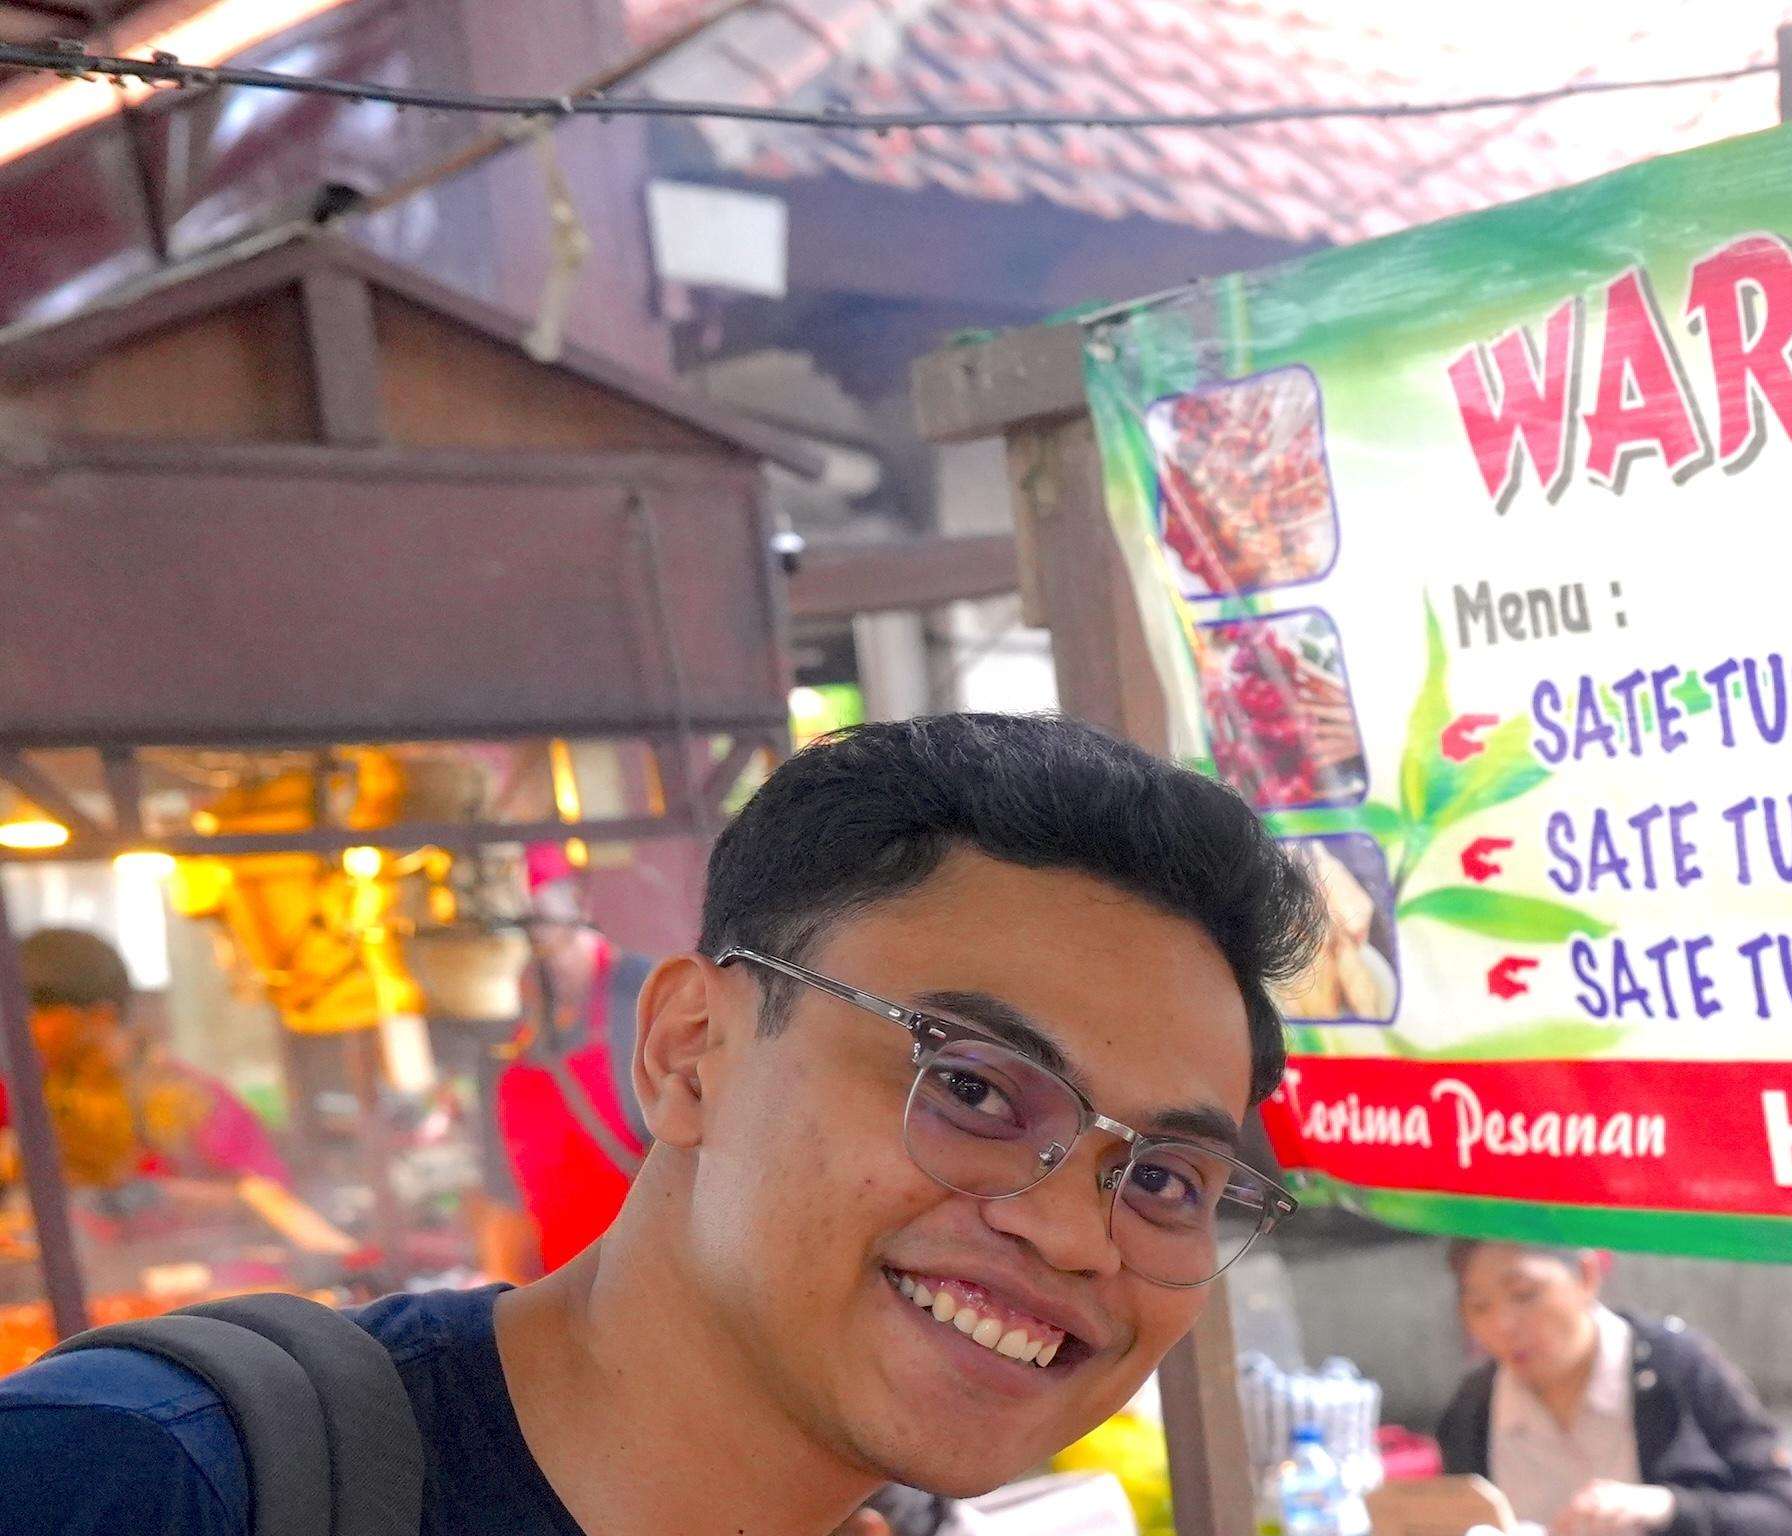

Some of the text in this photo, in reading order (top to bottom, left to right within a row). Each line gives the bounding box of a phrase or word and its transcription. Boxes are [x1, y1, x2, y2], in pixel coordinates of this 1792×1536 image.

[1453, 581, 1591, 648] Menu
[1534, 664, 1686, 763] SATE
[1547, 802, 1702, 894] SATE
[1571, 935, 1722, 1020] SATE
[1430, 1077, 1666, 1170] Pesanan
